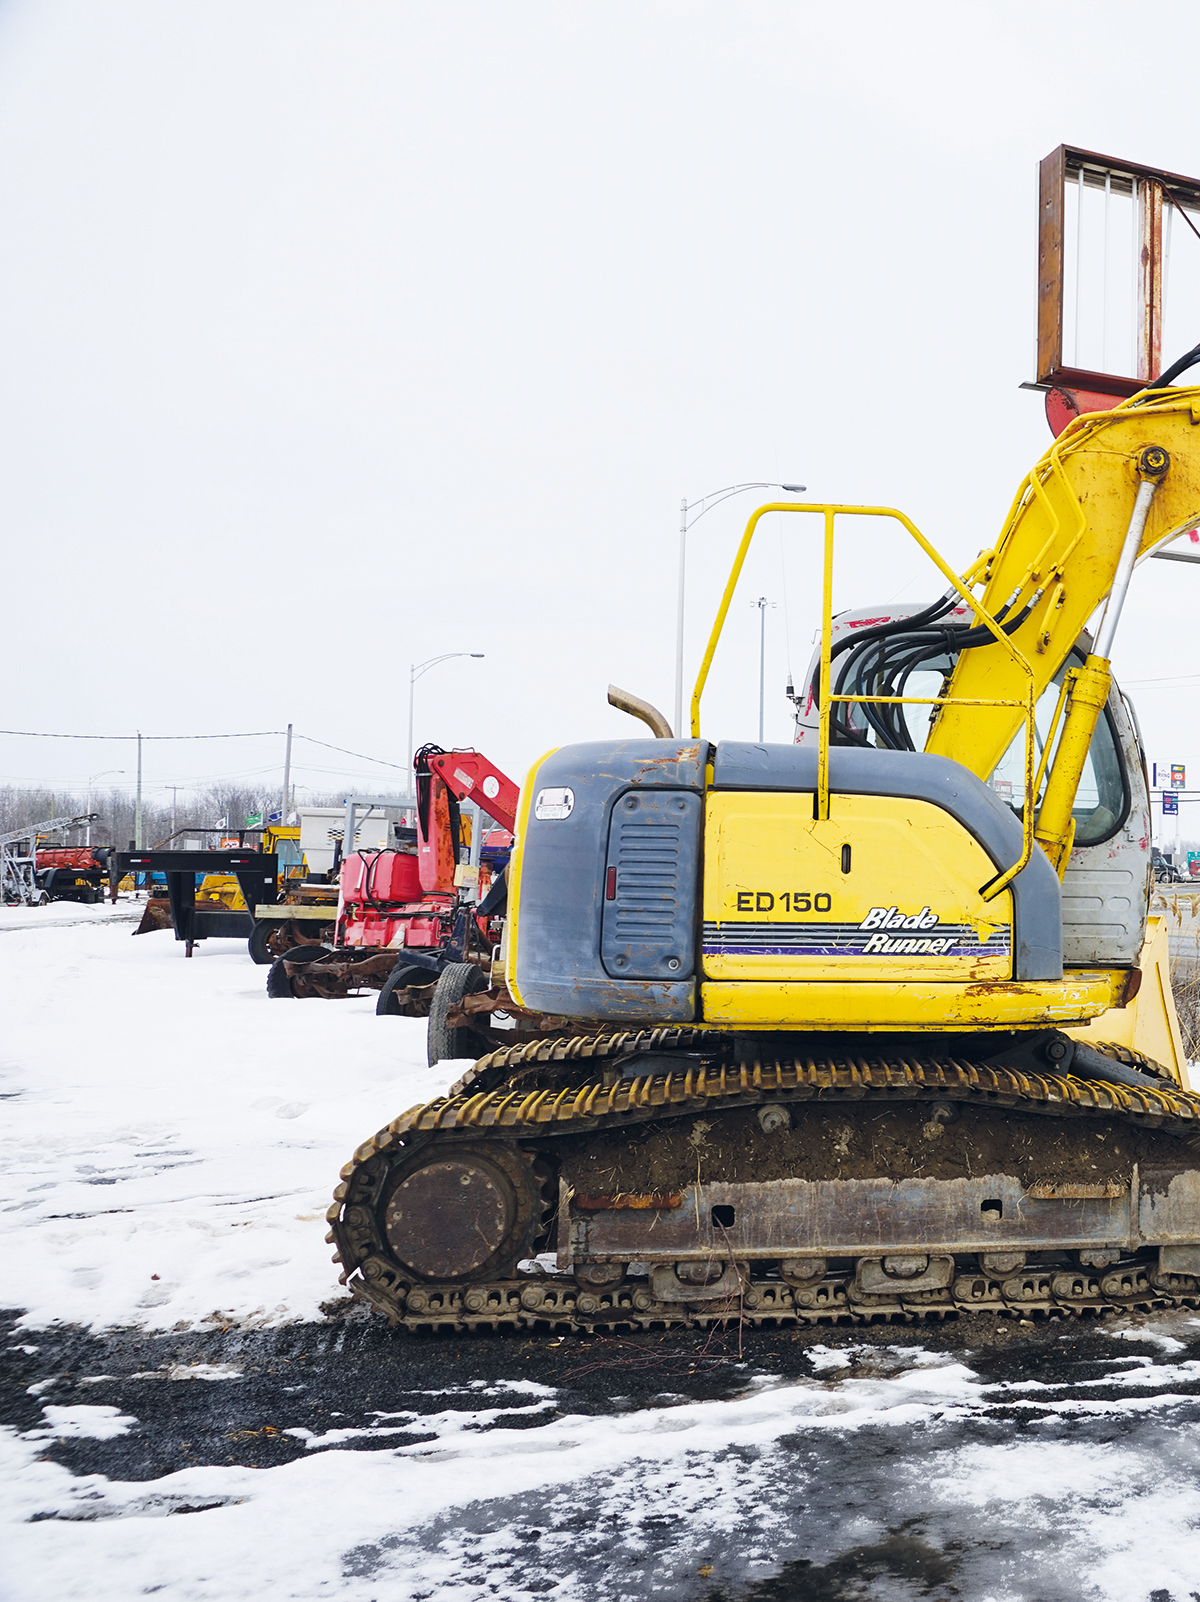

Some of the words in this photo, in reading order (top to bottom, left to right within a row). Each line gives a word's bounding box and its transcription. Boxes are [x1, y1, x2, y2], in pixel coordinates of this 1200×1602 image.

[737, 892, 774, 912] ED
[780, 892, 832, 912] 150
[858, 906, 939, 930] Blade
[862, 933, 960, 955] Runner
